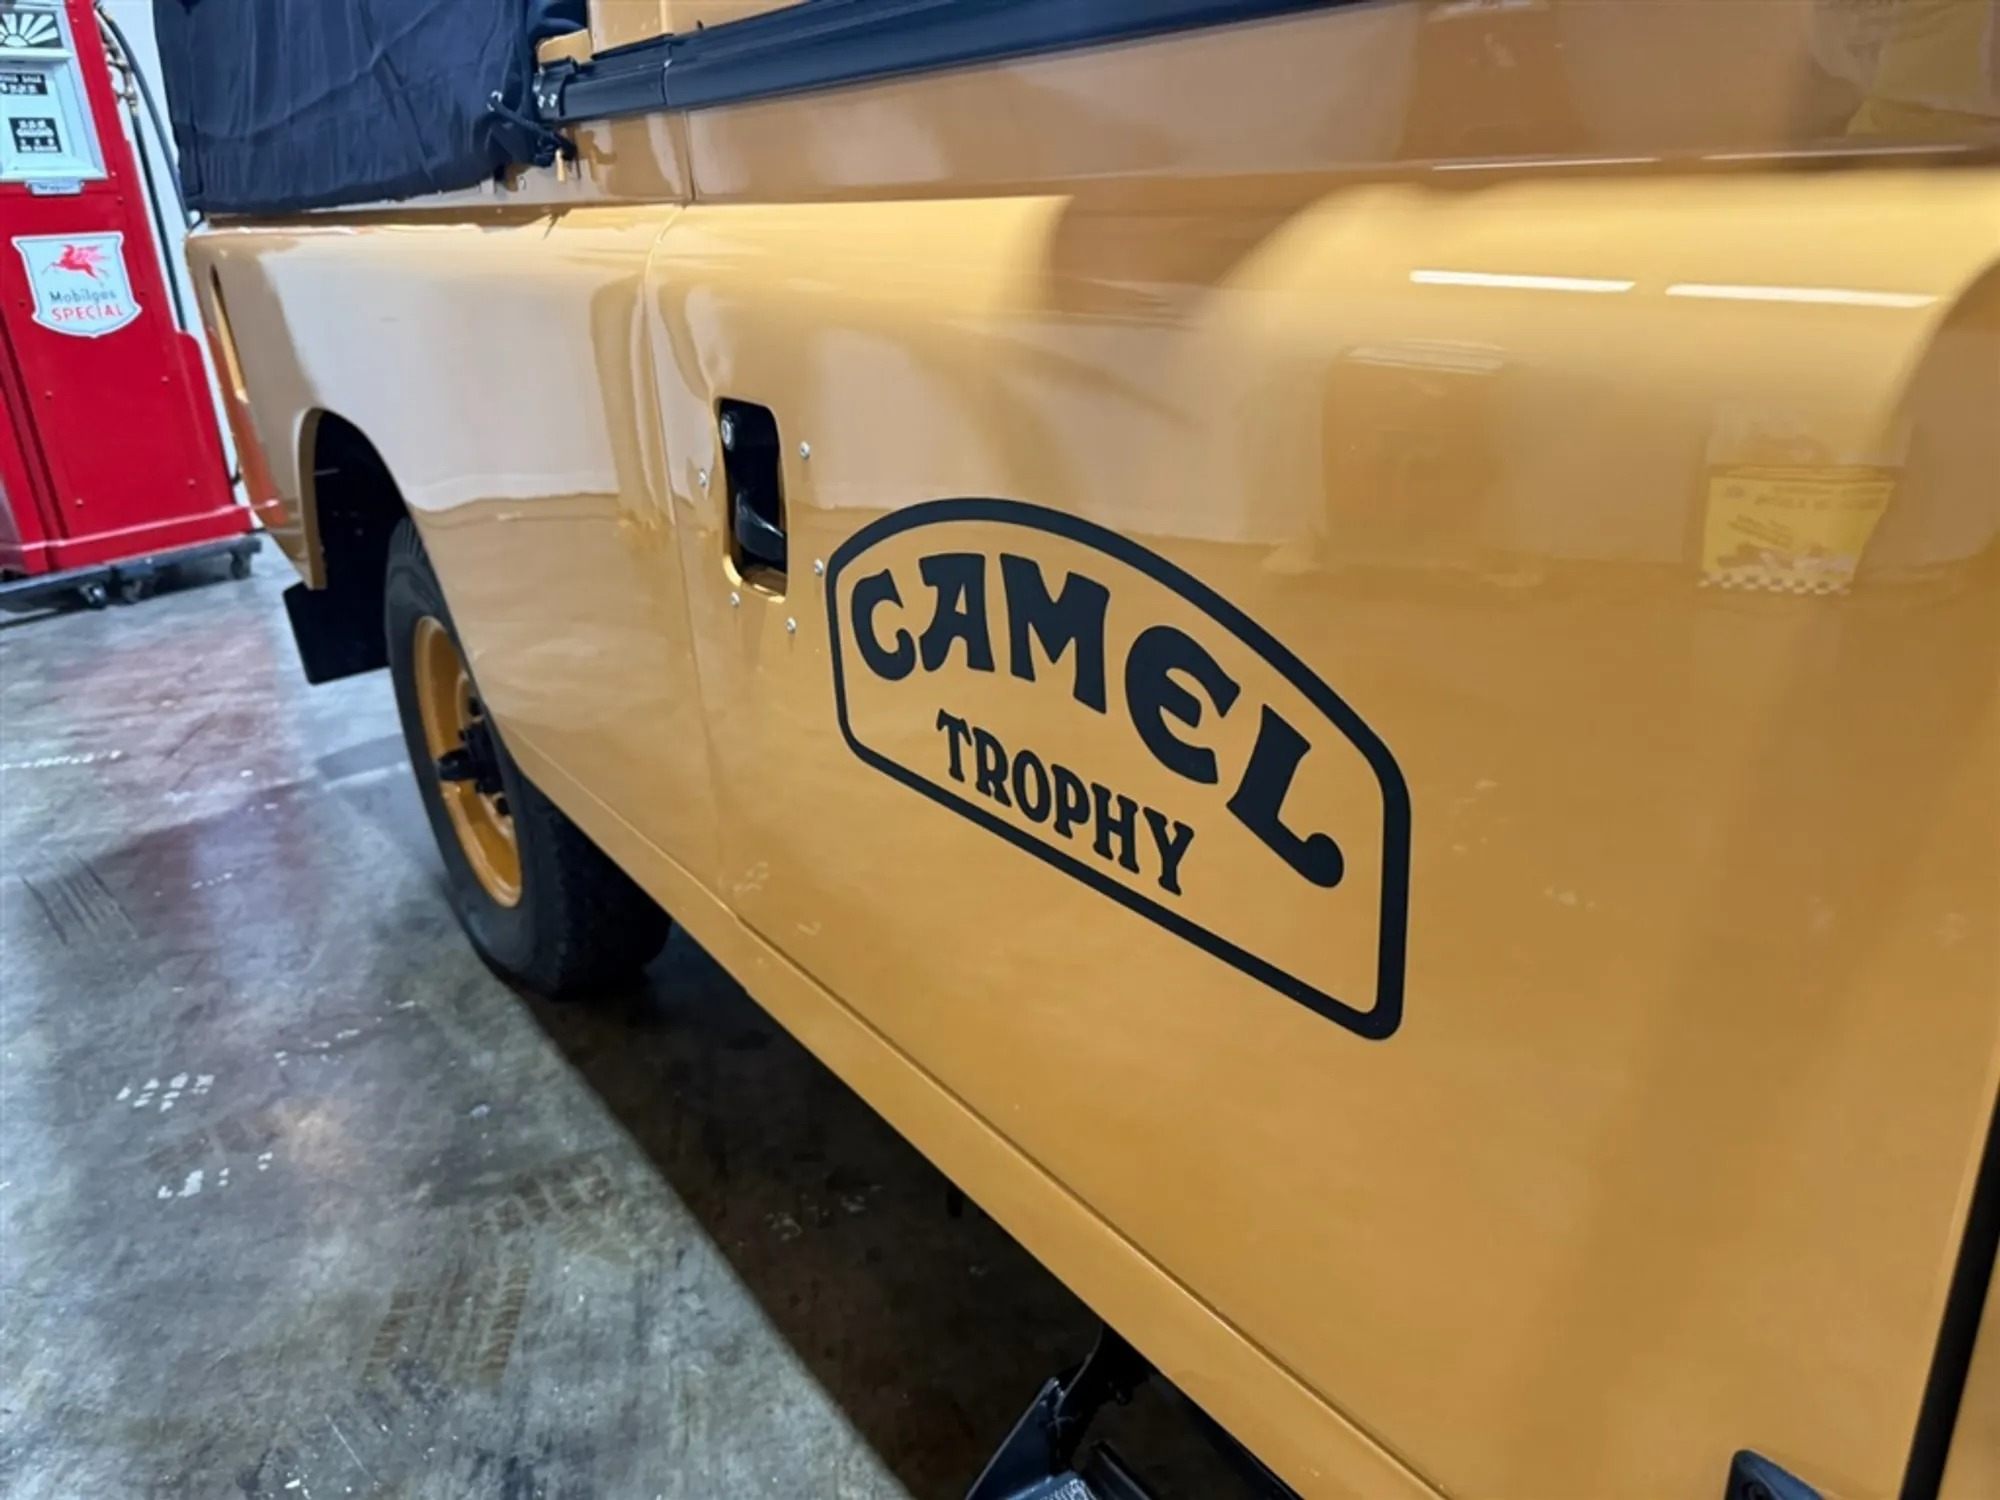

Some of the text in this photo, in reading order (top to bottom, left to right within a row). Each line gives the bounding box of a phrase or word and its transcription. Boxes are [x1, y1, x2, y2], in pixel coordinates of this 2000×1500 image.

[51, 303, 124, 321] SPECIAL
[851, 552, 1345, 889] CAMEL
[935, 708, 1195, 896] TROPHY
